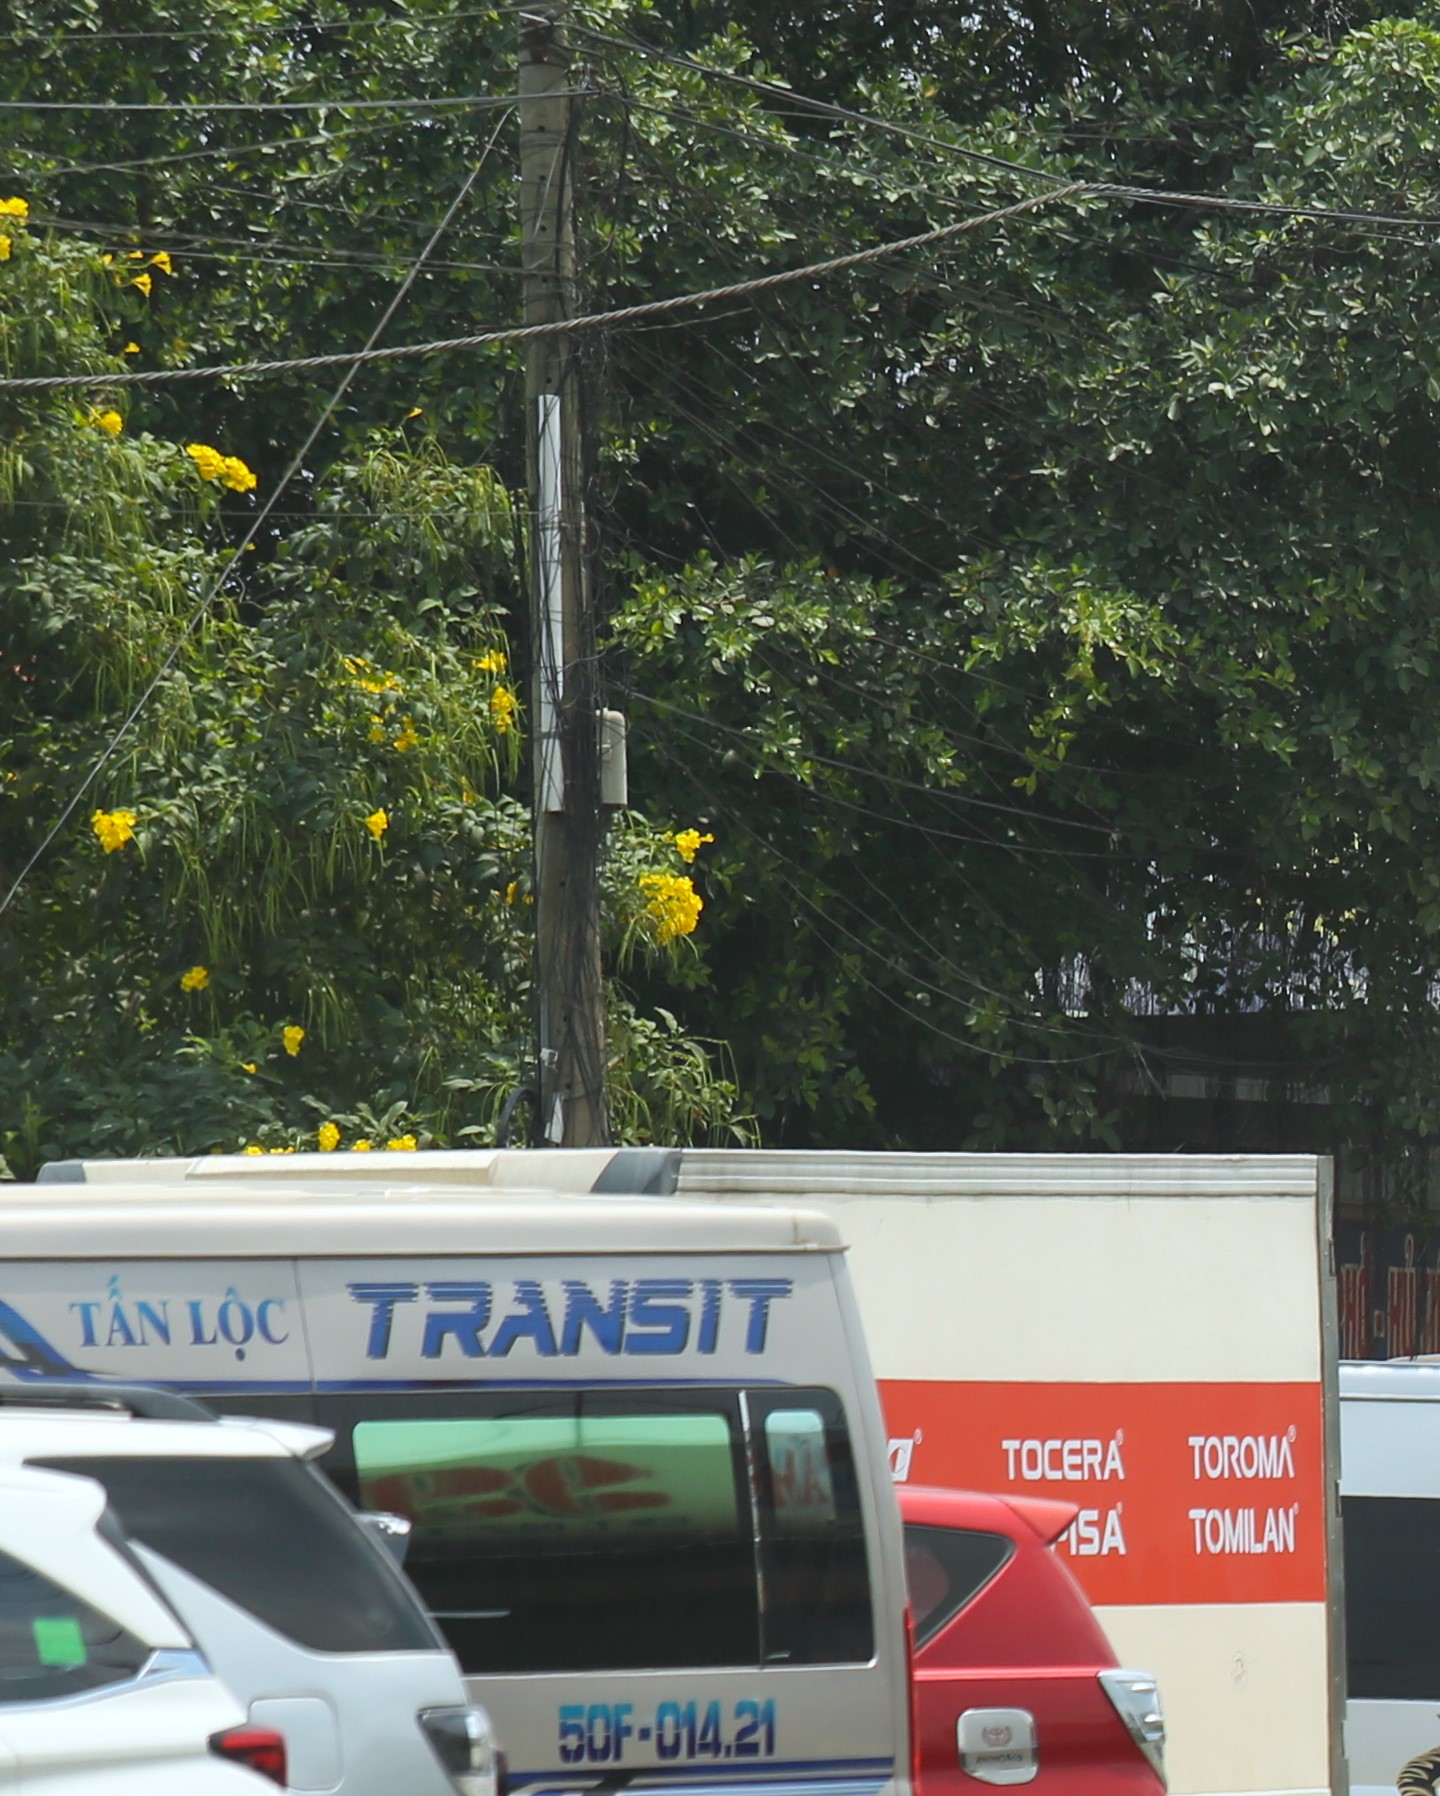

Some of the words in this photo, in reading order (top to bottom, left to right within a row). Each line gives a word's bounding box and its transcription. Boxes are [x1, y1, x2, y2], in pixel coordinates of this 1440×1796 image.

[69, 1274, 171, 1348] TẤN
[186, 1286, 290, 1362] LỘC
[346, 1278, 795, 1360] TRANSIT
[1001, 1438, 1126, 1481] TOCERA
[1187, 1434, 1297, 1480] TOROMA
[1188, 1505, 1297, 1555] TOMILAN
[557, 1697, 777, 1766] 50F-014.21
